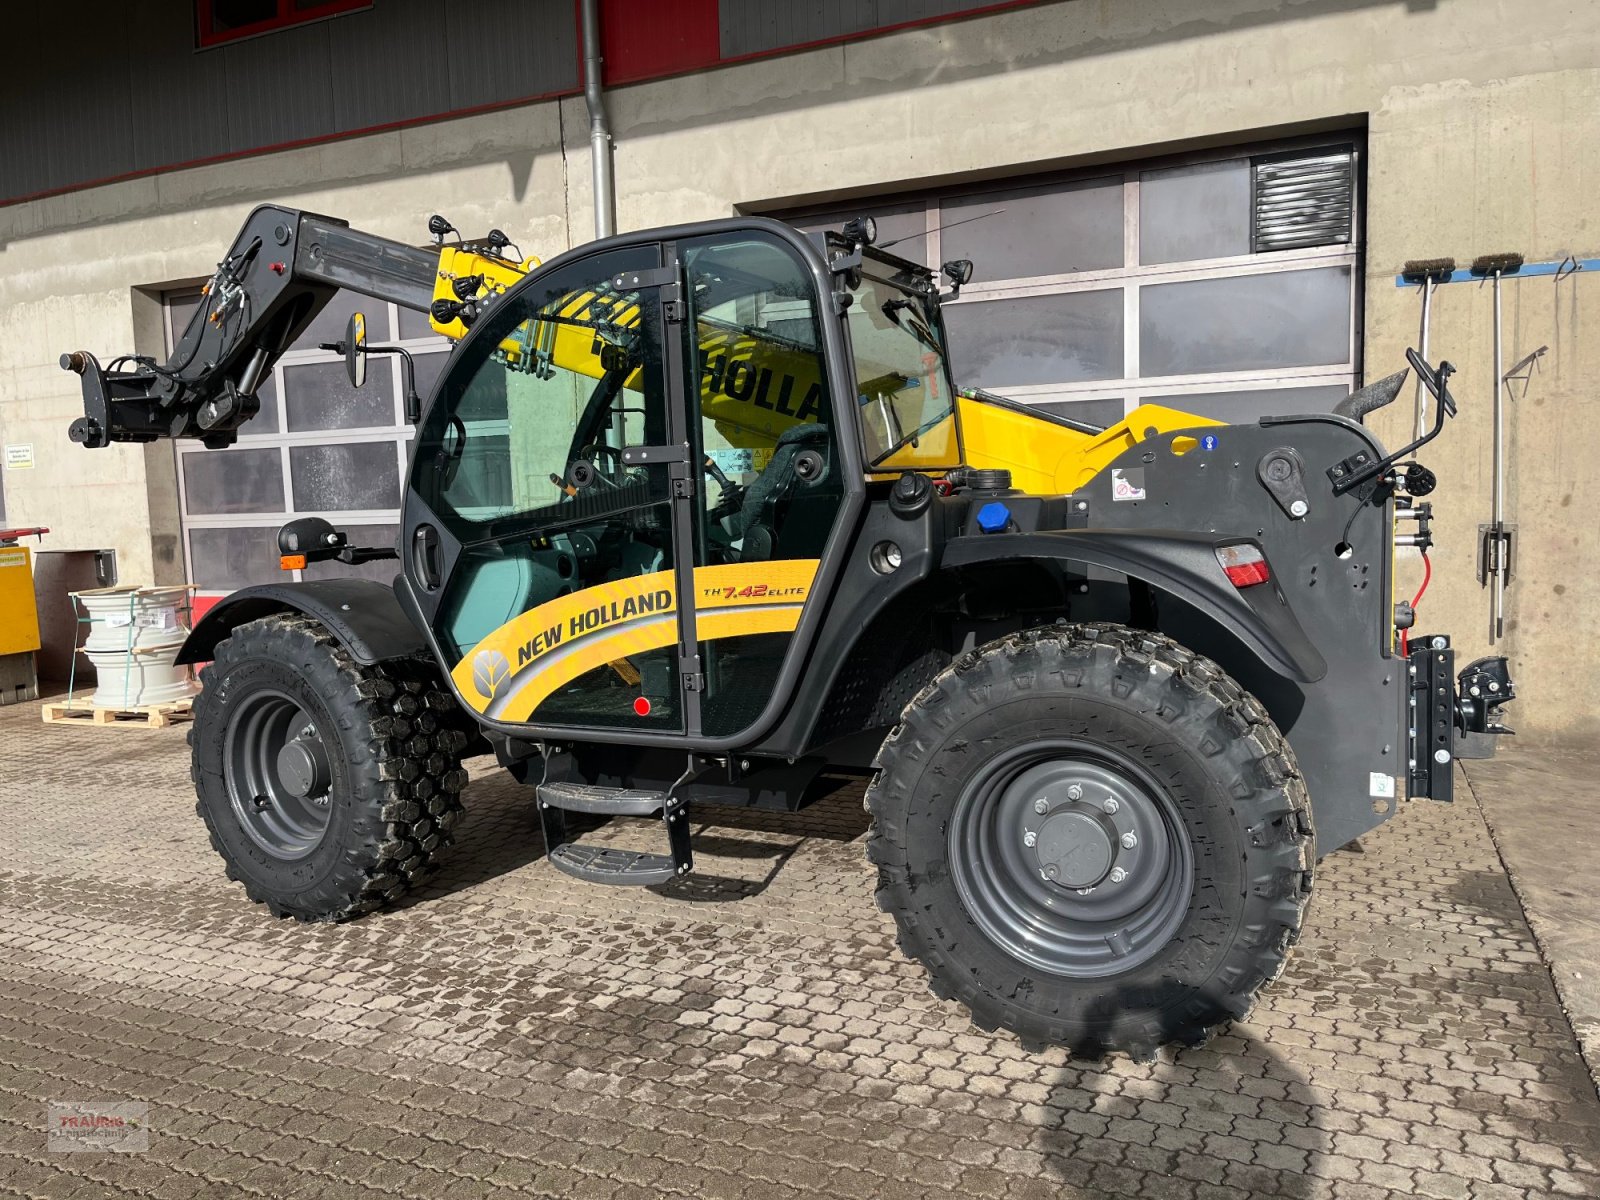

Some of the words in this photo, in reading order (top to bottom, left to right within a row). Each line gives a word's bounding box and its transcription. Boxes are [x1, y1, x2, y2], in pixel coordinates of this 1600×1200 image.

[723, 584, 768, 599] 7.42
[768, 587, 804, 596] ELITE
[518, 623, 563, 667] NEW
[570, 589, 672, 637] HOLLAND
